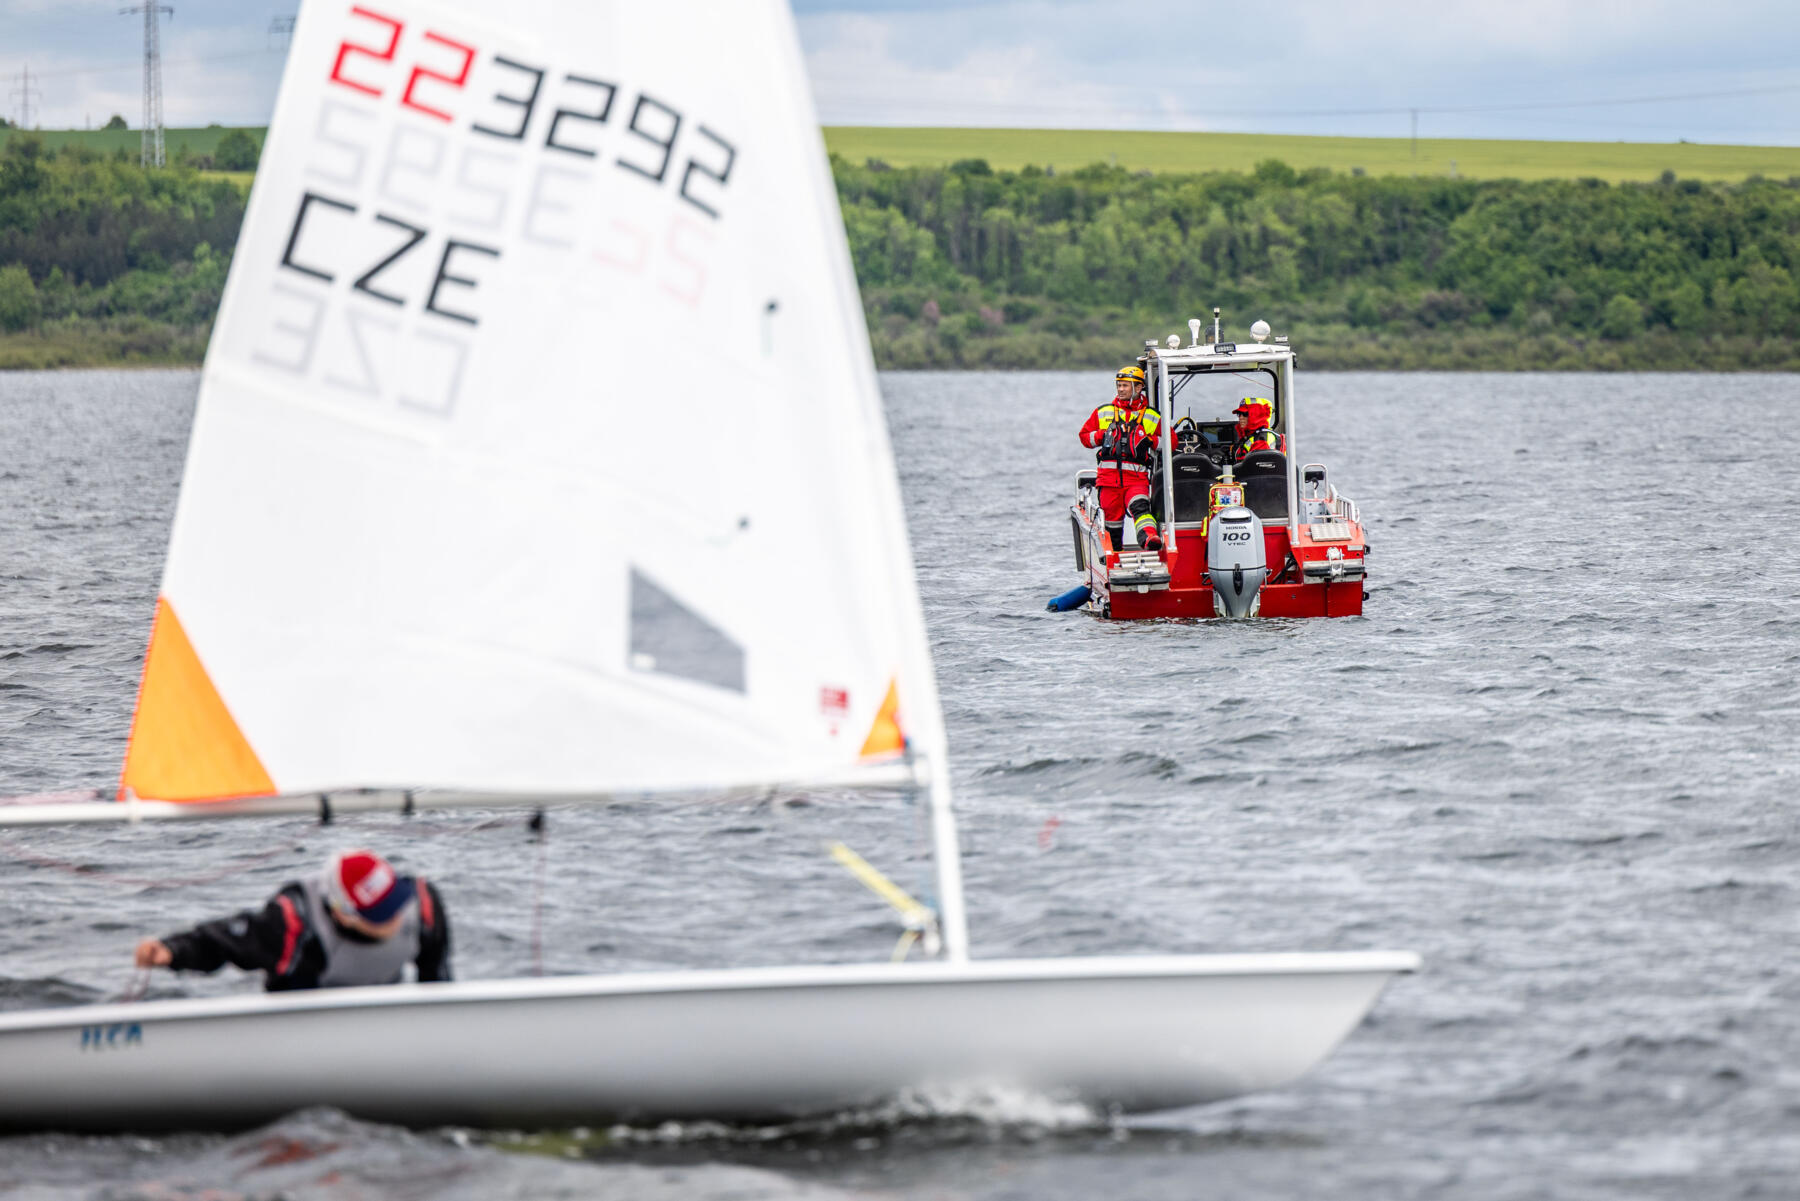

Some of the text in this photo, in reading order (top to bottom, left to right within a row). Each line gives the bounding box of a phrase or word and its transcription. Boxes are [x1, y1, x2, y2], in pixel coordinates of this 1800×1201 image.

[327, 4, 737, 220] 223292
[279, 191, 502, 327] CZE
[1222, 532, 1251, 542] 100
